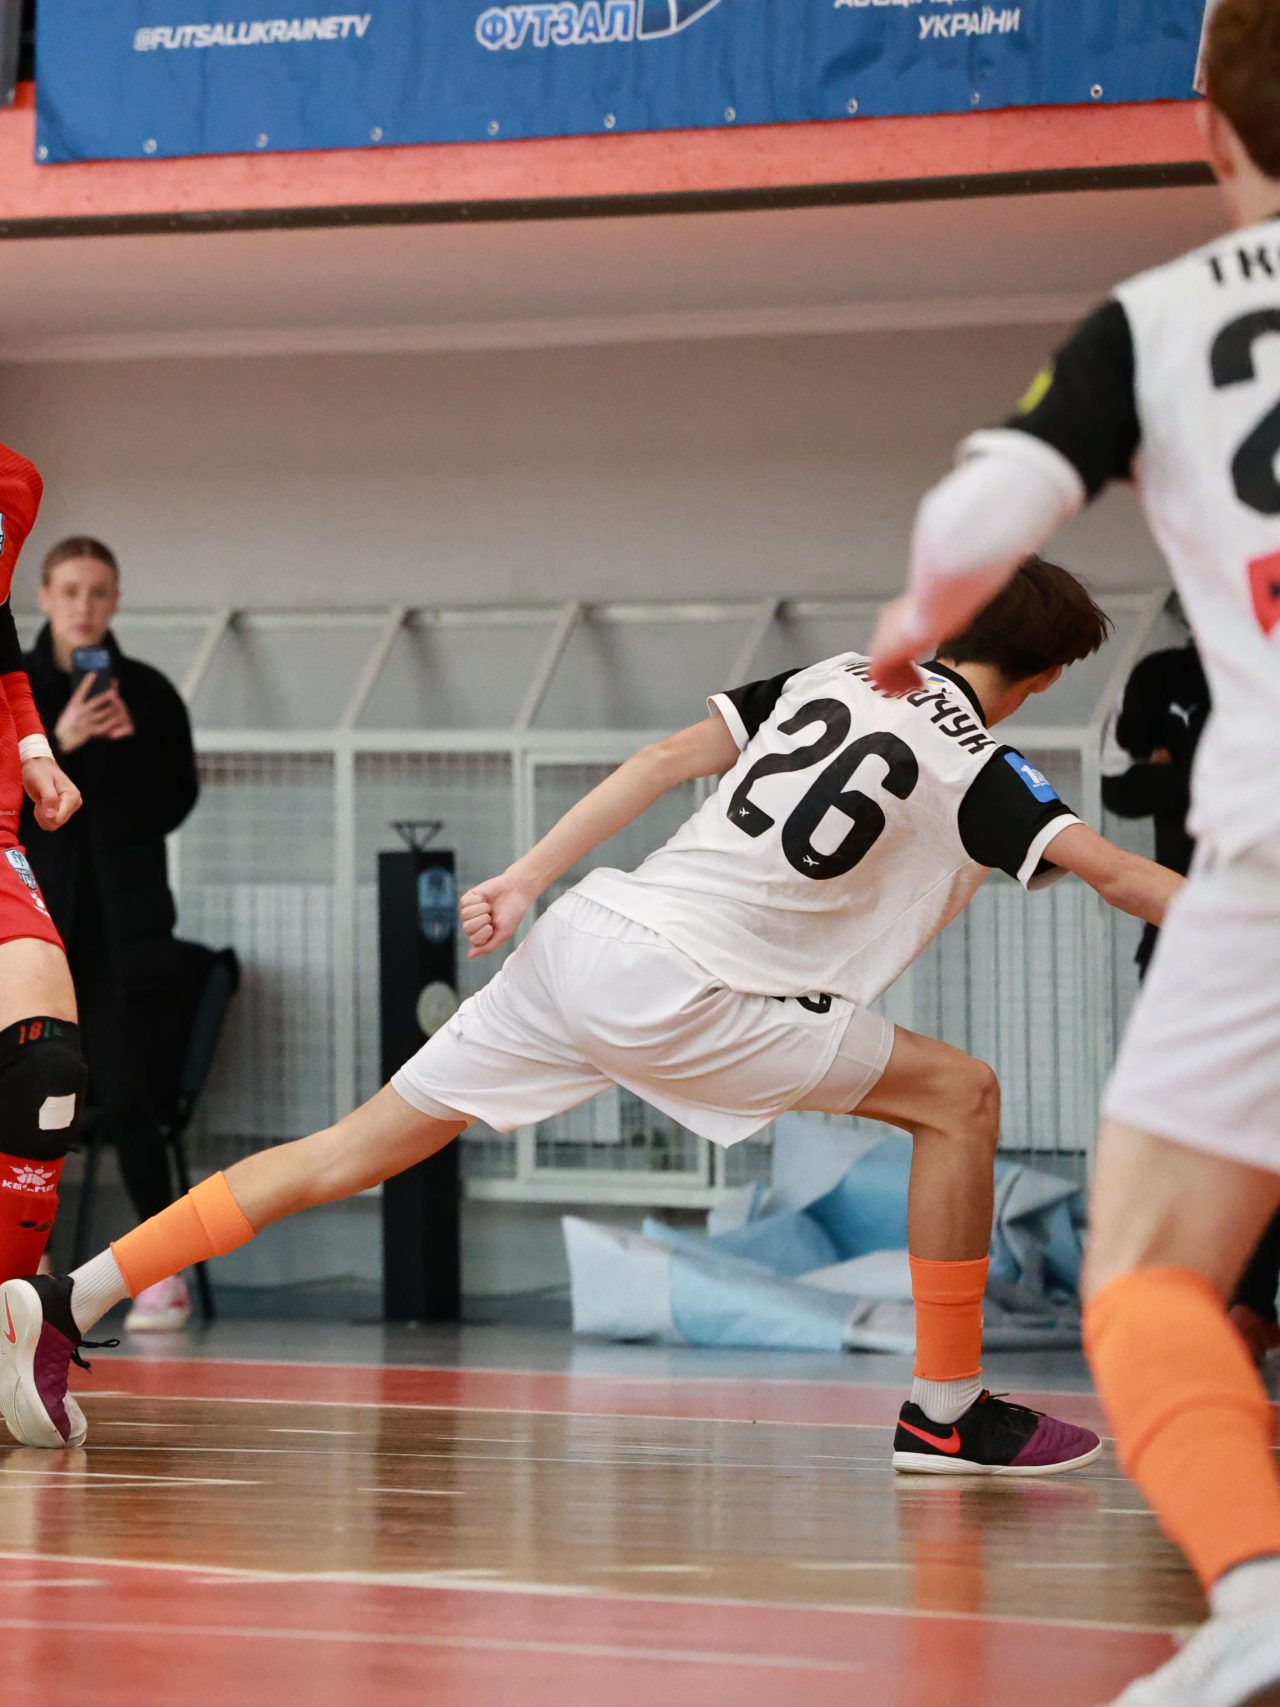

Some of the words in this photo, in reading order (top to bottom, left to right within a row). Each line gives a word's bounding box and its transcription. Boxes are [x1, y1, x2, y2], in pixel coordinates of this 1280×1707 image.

[134, 14, 371, 51] @FUTSALUKRAINETV
[476, 1, 636, 49] ФУТЗАЛ
[919, 7, 1020, 39] УКРАЇНИ
[726, 698, 919, 880] 26
